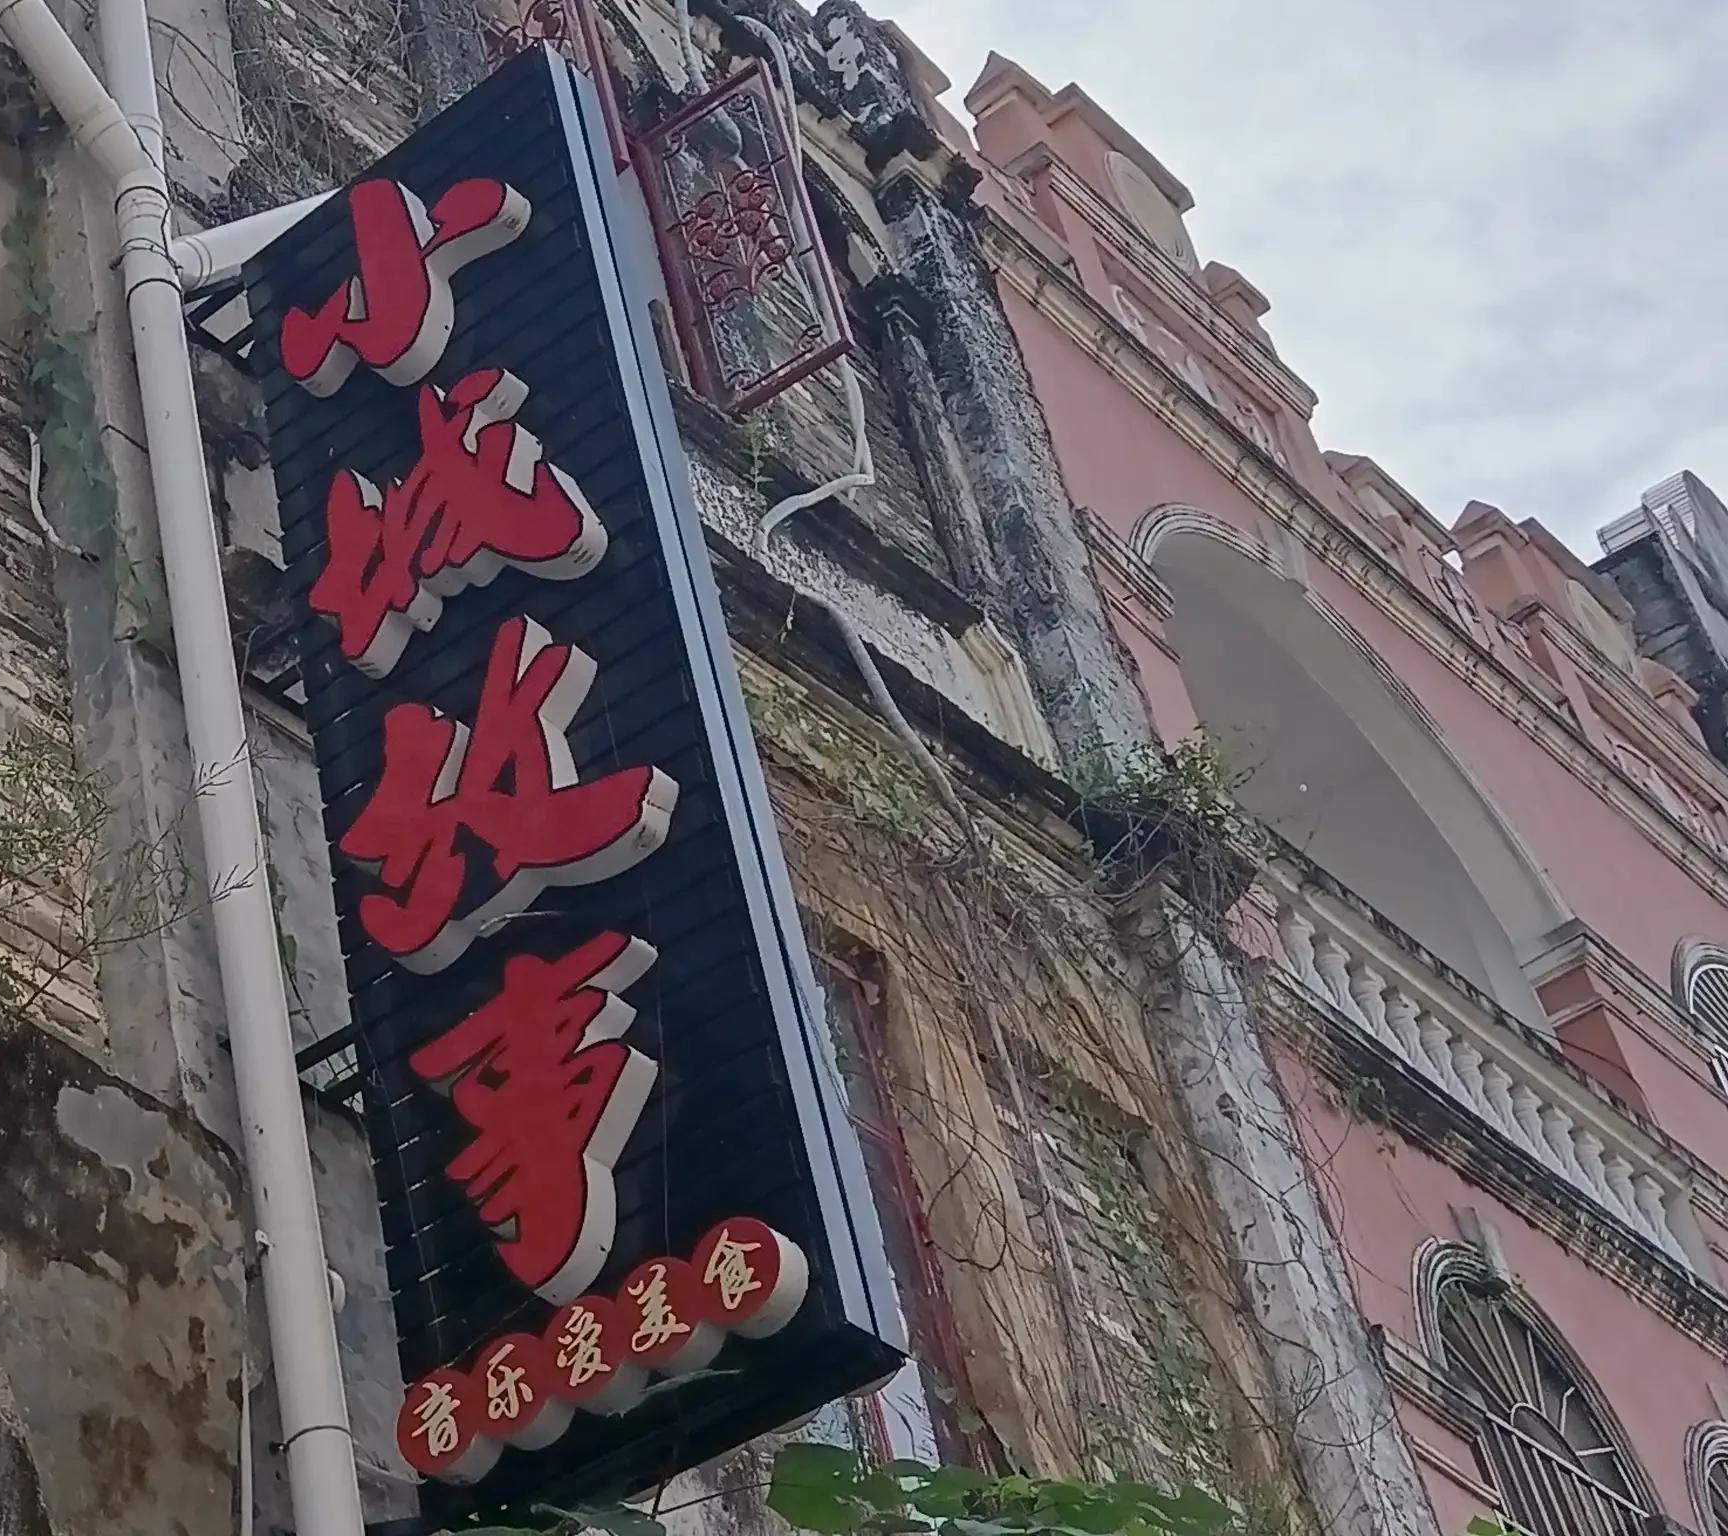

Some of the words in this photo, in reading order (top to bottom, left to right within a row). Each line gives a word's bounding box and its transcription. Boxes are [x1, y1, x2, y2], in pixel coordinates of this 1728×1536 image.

[280, 178, 675, 1300] 小城故事
[411, 1228, 762, 1457] 音乐爱美食
